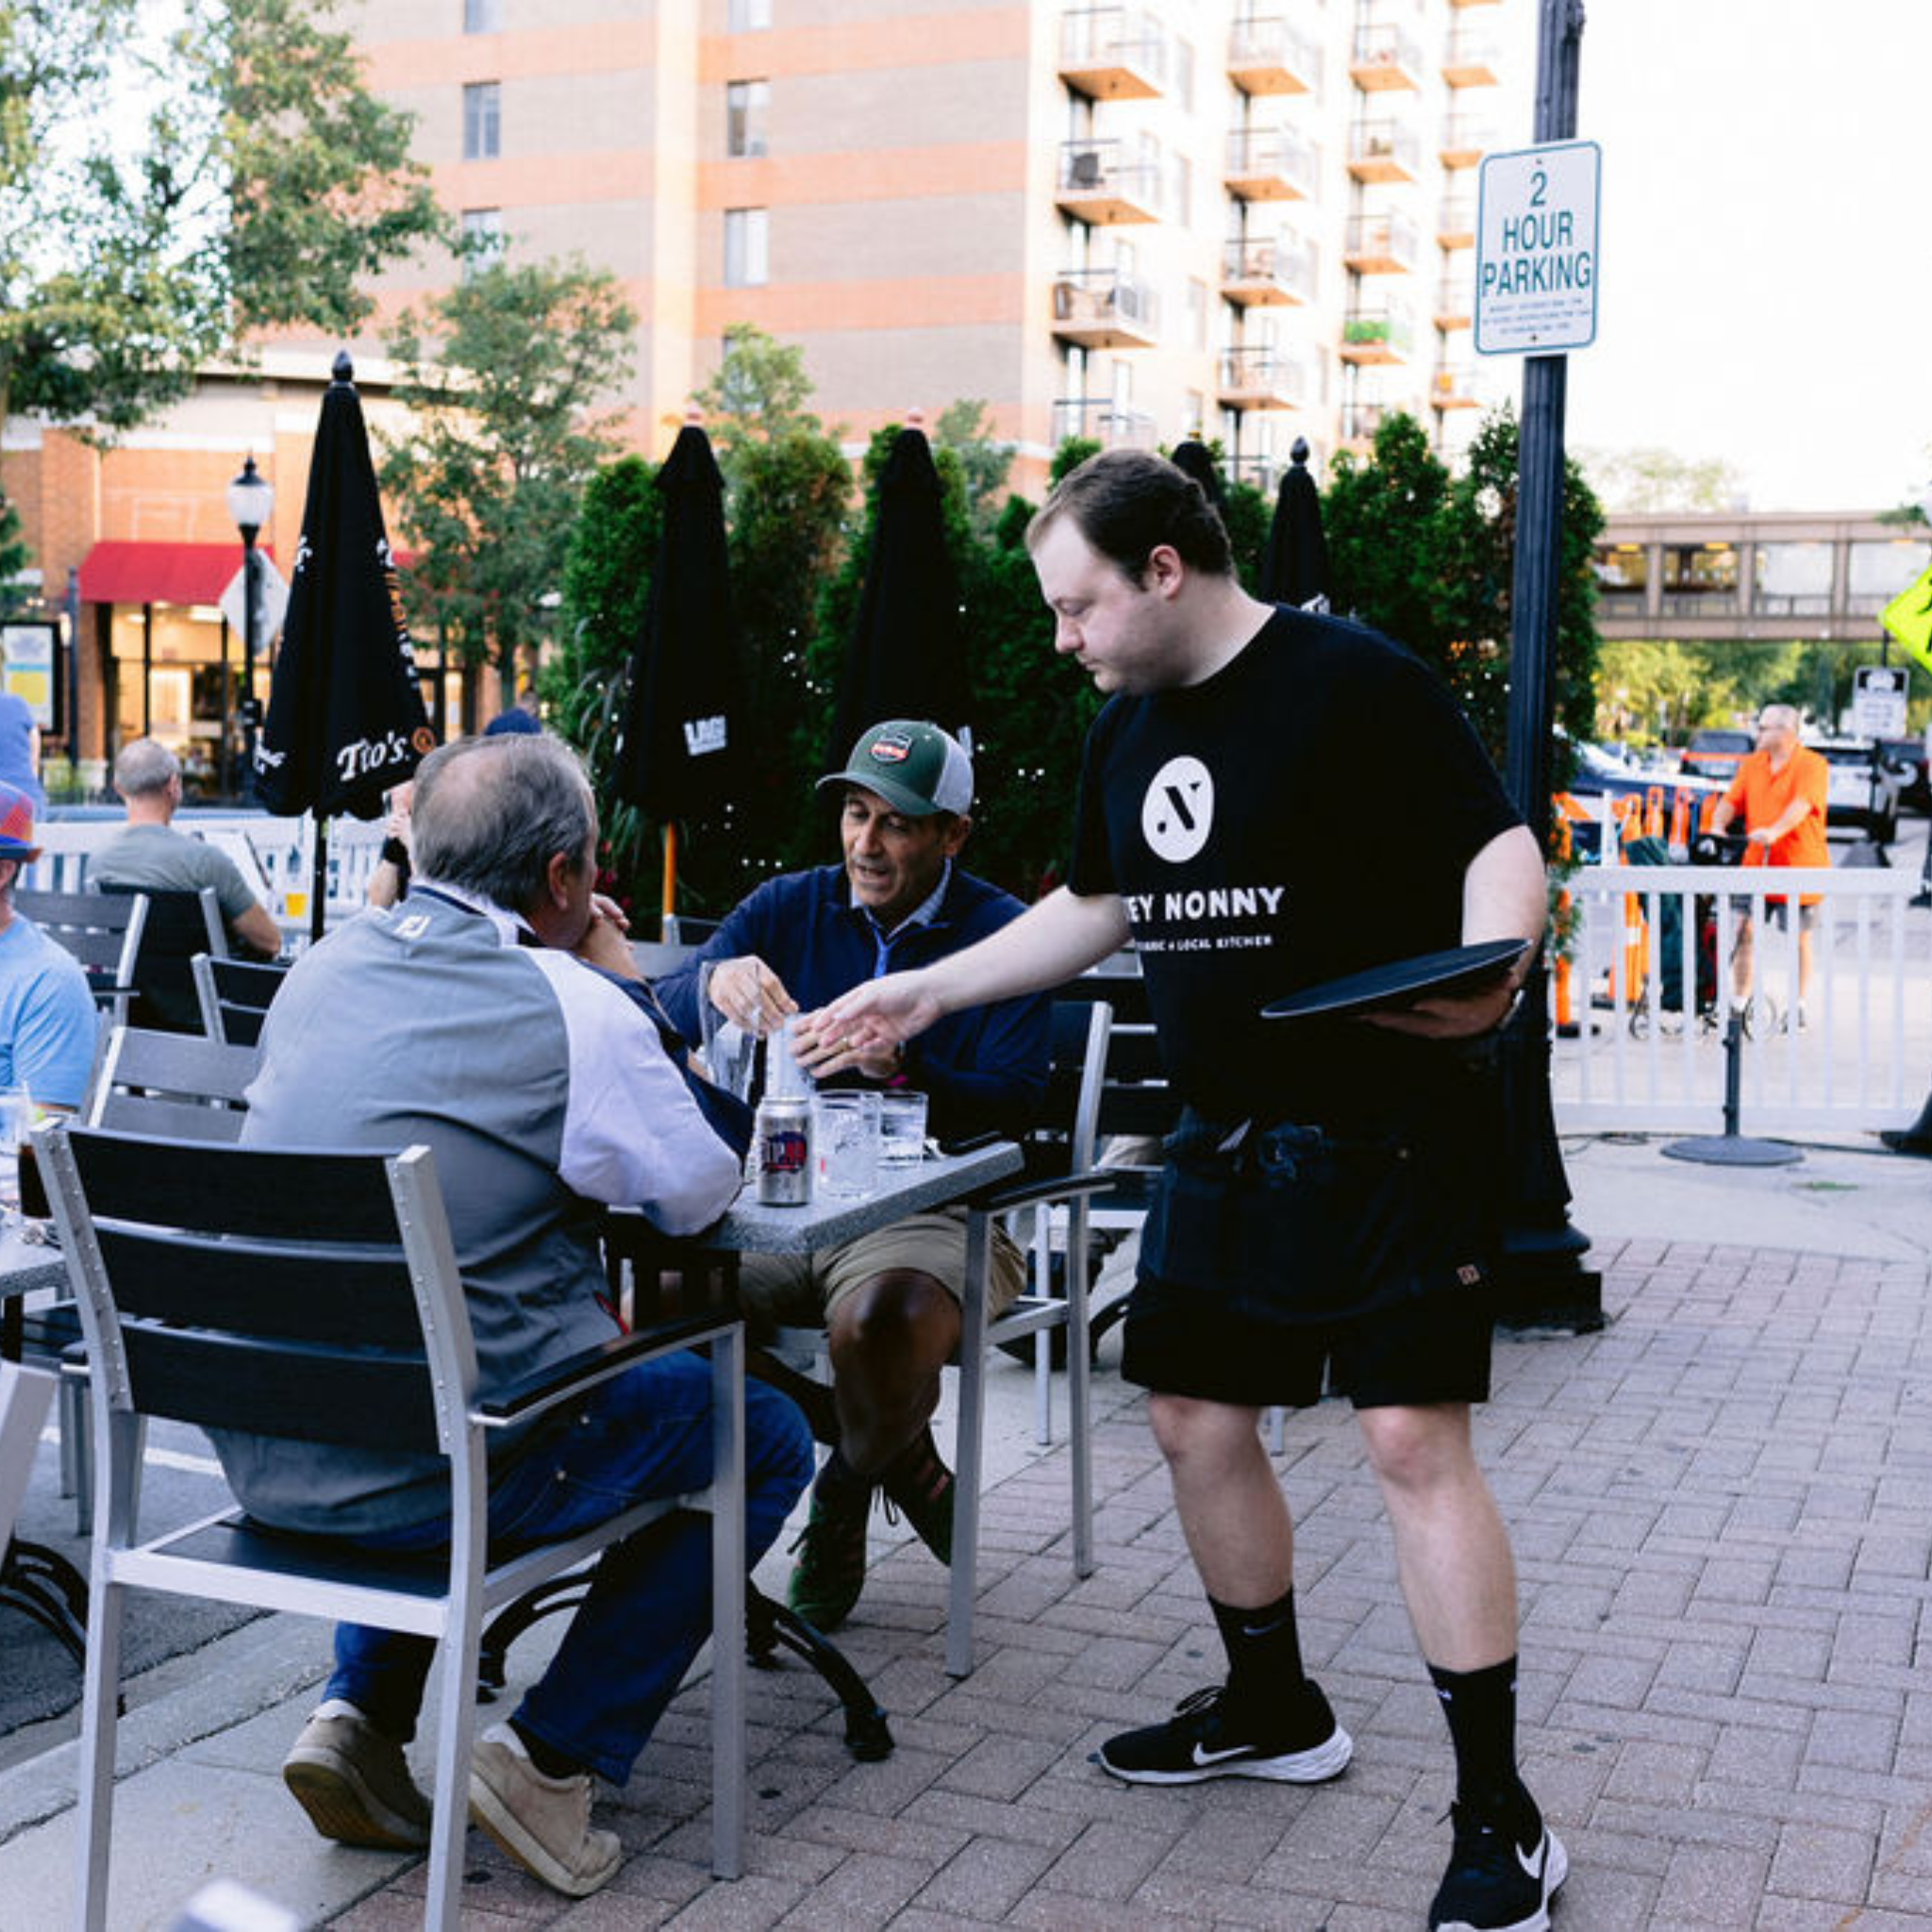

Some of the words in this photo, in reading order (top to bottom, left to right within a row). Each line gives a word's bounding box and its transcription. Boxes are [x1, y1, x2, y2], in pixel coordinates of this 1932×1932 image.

[1529, 172, 1547, 207] 2
[1502, 211, 1574, 252] HOUR
[1482, 252, 1591, 297] PARKING
[1126, 893, 1154, 923] EY
[1165, 886, 1285, 921] NONNY
[1176, 938, 1211, 952] LOCAL
[1215, 934, 1272, 950] KITCHEN
